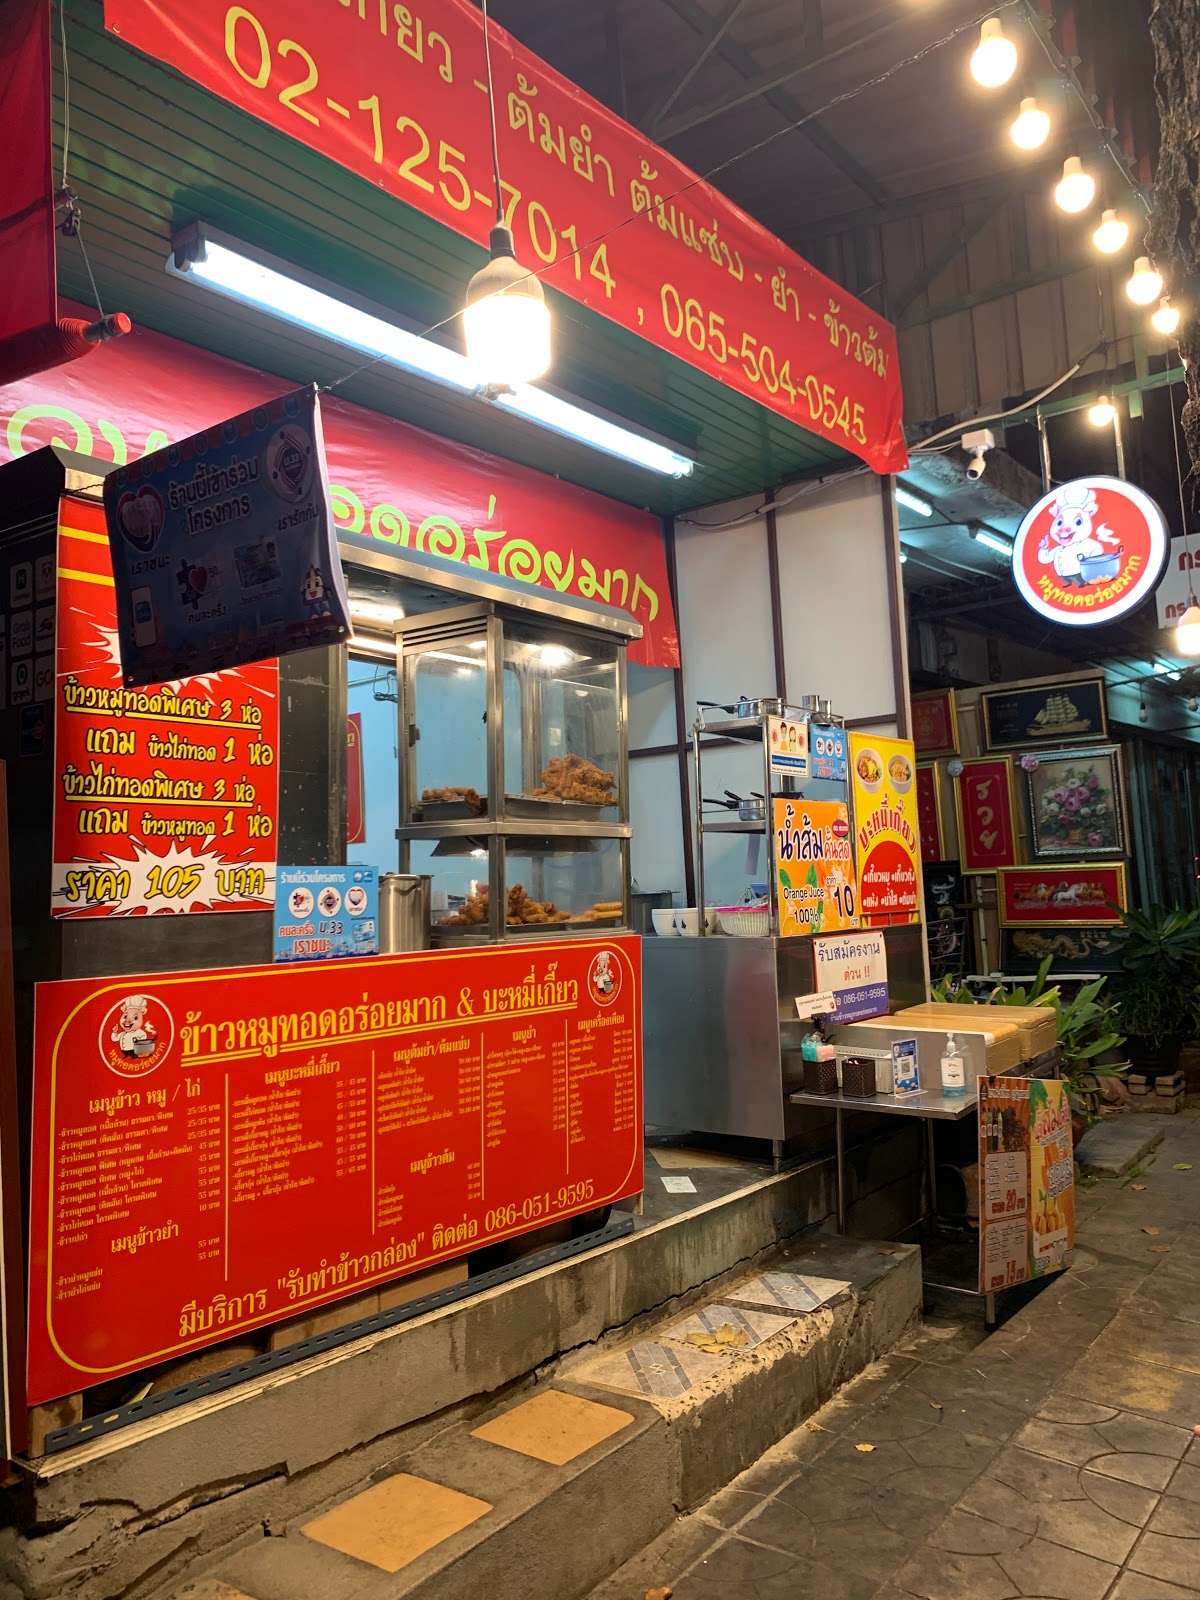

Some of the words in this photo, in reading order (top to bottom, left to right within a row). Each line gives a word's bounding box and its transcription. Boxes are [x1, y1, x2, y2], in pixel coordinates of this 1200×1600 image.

[223, 5, 617, 301] 02-125-7014
[660, 283, 867, 446] 065-504-0545
[508, 73, 614, 197] ต้มยำ
[630, 154, 744, 282] ต้มแซ่บ
[771, 265, 800, 322] ยำ
[824, 298, 889, 381] ข้าวต้ม
[169, 457, 259, 510] ร้านนี้เข้าร่วม
[187, 496, 250, 534] โครงการ
[1036, 554, 1142, 608] หมูทอดอร่อยมาก
[12, 635, 31, 648] Food
[64, 676, 211, 718] ข้าวหมูทอดพิเศษ
[219, 699, 233, 722] 3
[241, 698, 262, 724] ห่อ
[86, 727, 135, 755] แถม
[148, 732, 216, 762] ข้าวไก่ทอด
[223, 737, 236, 763] 1
[249, 735, 274, 766] ห่อ
[62, 761, 203, 800] ข้าวไก่ทอดพิเศษ
[212, 778, 226, 801] 3
[234, 776, 256, 802] ห่อ
[78, 808, 129, 835] แถม
[141, 812, 216, 841] ข้าวหมูทอด
[221, 810, 236, 837] 1
[247, 805, 274, 838] ห่อ
[778, 804, 824, 861] น้ำส้ม
[65, 869, 131, 901] ราคา
[144, 865, 204, 900] 105
[215, 867, 265, 897] บาท
[783, 887, 808, 902] Orange
[809, 886, 824, 898] Juce
[794, 907, 818, 923] 100%
[834, 885, 855, 918] 10
[278, 920, 315, 937] คนละครึ่ง
[319, 921, 344, 936] ม.33
[294, 938, 332, 955] เราชนะ
[818, 940, 881, 962] รับสมัครงาน
[844, 966, 861, 981] ด่วน
[864, 965, 870, 978] !!
[180, 992, 446, 1057] ข้าวหมูทอดอร่อยมาก
[456, 987, 475, 1017] &
[483, 961, 578, 1014] บะหมี่เกี๊ยว
[843, 987, 886, 1005] 086-051-9595
[513, 1024, 537, 1044] เมนูยำ
[577, 1011, 625, 1033] เมนูเครื่องเคียง
[109, 1041, 166, 1072] หมูทอดอร่อยมาก
[394, 1035, 470, 1065] เมนูต้มยำ/ต้มแซ่บ
[265, 1054, 340, 1087] เมนูบะหมี่เกี๊ยว
[89, 1089, 140, 1116] เมนูข้าว
[146, 1088, 166, 1108] หมู
[186, 1078, 201, 1097] ไก่
[187, 1106, 206, 1116] 25/35
[187, 1118, 206, 1128] 25/35
[187, 1130, 206, 1140] 25/35
[410, 1148, 455, 1175] เมนูข้าวต้ม
[111, 1219, 179, 1254] เมนูข้าวยำ
[179, 1288, 267, 1337] มีบริการ
[277, 1231, 425, 1300] "รับทำข้าวกล่อง"
[432, 1215, 478, 1250] ติดต่อ
[484, 1179, 594, 1232] 086-051-9595
